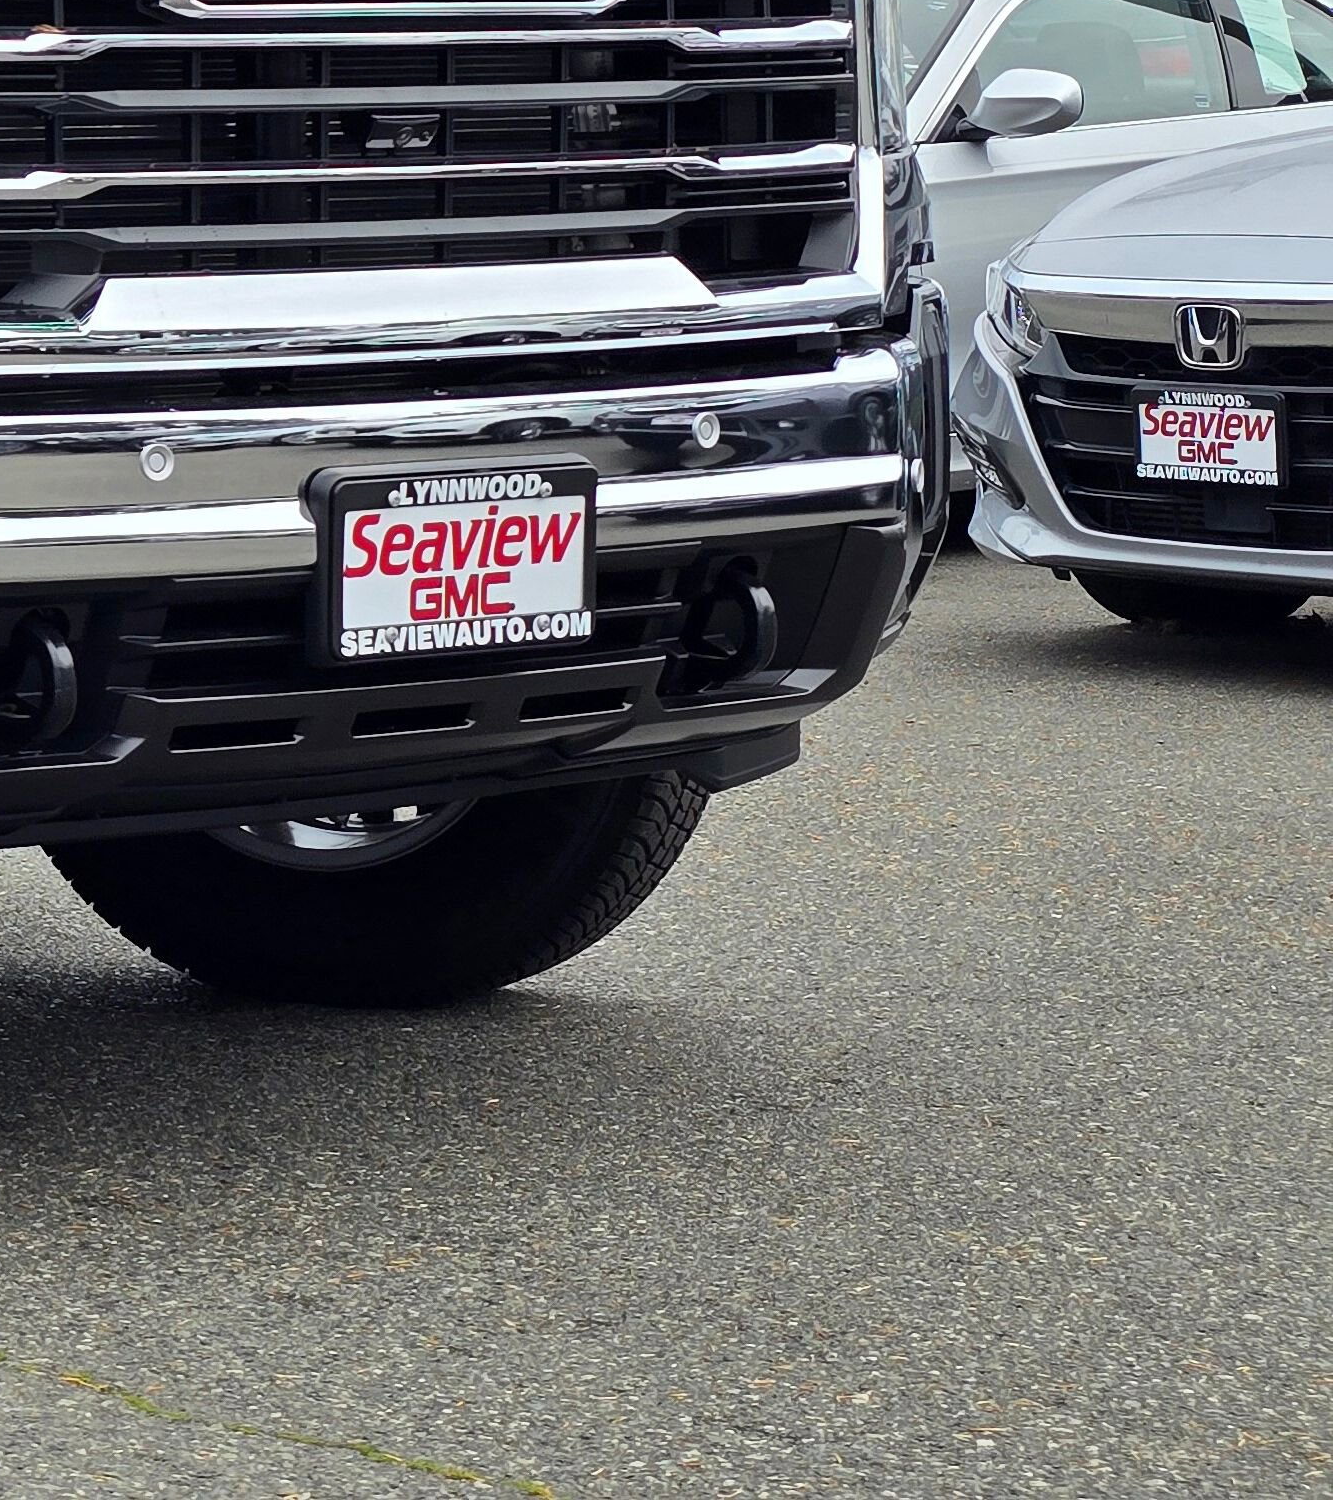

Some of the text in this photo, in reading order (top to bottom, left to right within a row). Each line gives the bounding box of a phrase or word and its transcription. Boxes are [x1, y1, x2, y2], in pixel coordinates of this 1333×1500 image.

[1164, 390, 1246, 408] LYNNWOOD
[1143, 403, 1275, 442] Seaview
[1178, 439, 1238, 465] GMC
[399, 473, 542, 506] LYNNWOOD
[1136, 463, 1279, 486] SEAVIEWAUTO.COM
[343, 504, 582, 578] Seaview
[409, 571, 516, 621] GMC
[340, 611, 592, 658] SEAVIEWAUTO.COM
